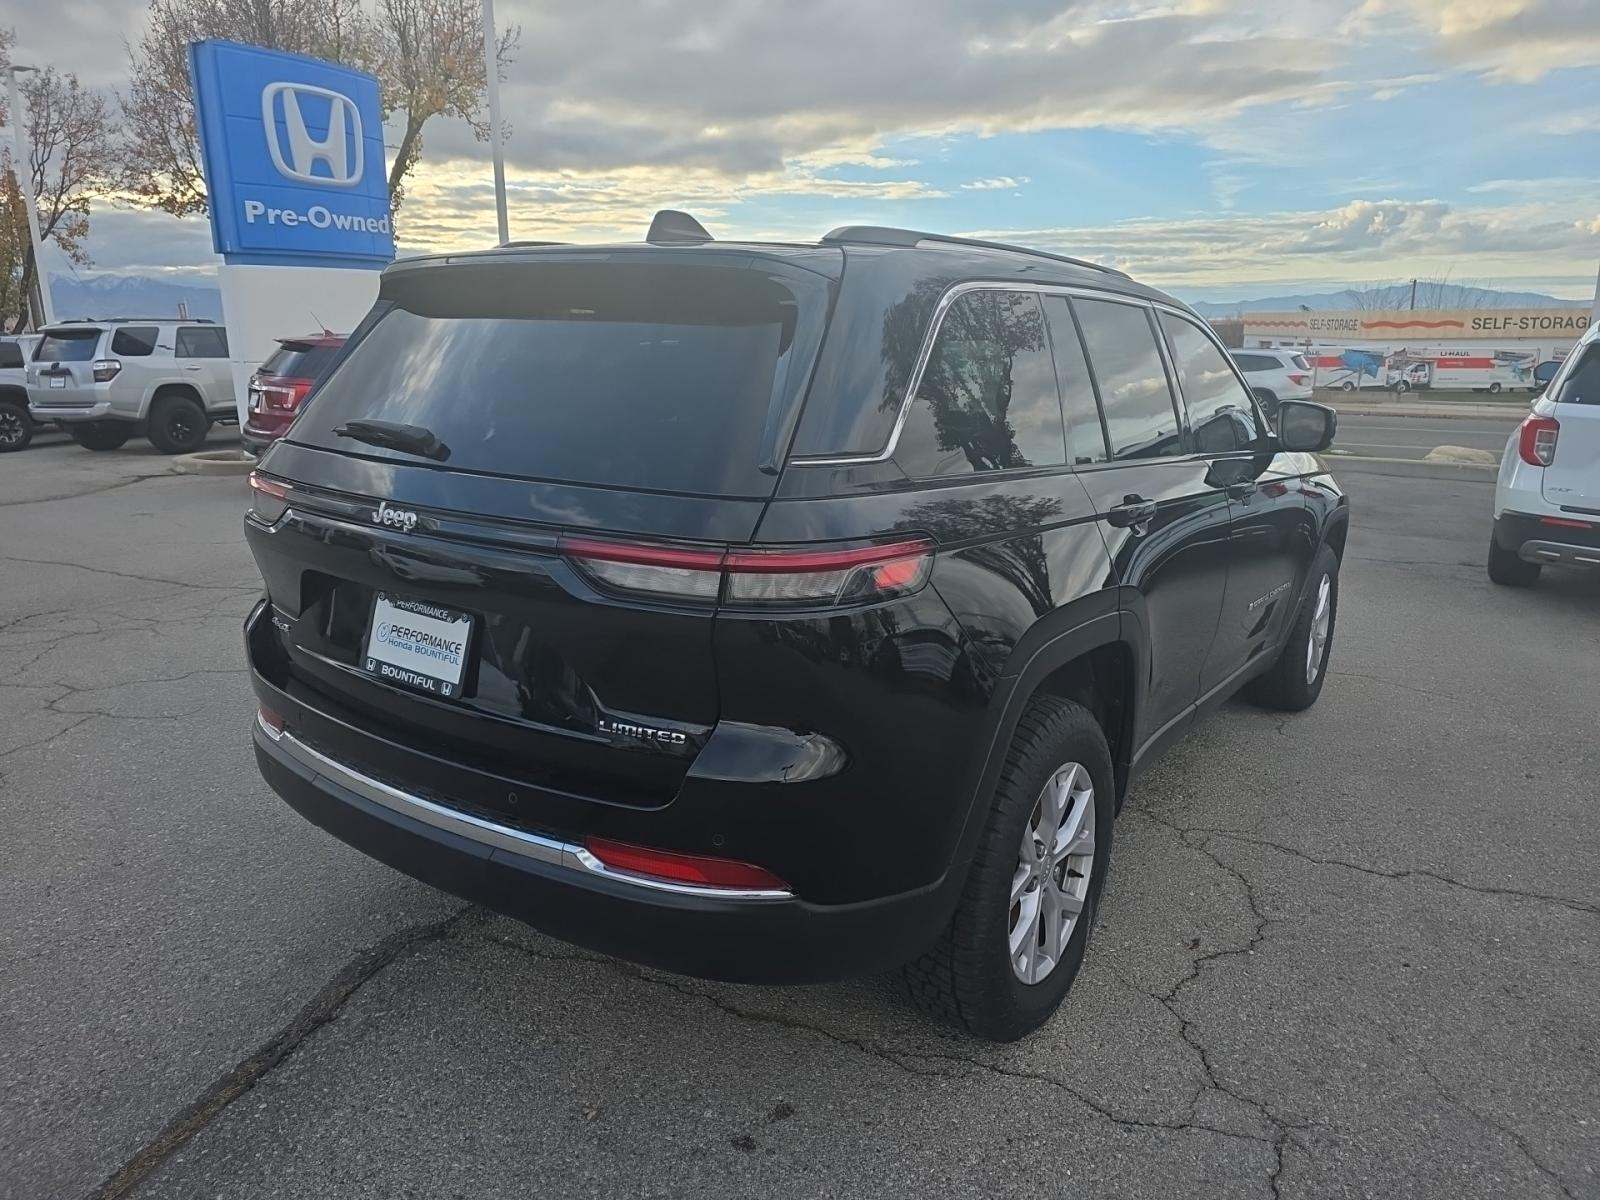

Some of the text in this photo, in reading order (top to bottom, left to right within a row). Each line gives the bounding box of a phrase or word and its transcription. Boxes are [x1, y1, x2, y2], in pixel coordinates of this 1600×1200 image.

[244, 200, 390, 234] Pre-Owned
[1309, 318, 1359, 330] SELF-STORAGE
[372, 501, 417, 533] Jeep
[397, 600, 449, 619] PERFORMANCE
[388, 638, 460, 666] Honda BOUNTIFUL
[390, 624, 462, 655] PERFORMANCE
[381, 664, 436, 690] BOUNTIFUL
[599, 720, 686, 744] LIMITED
